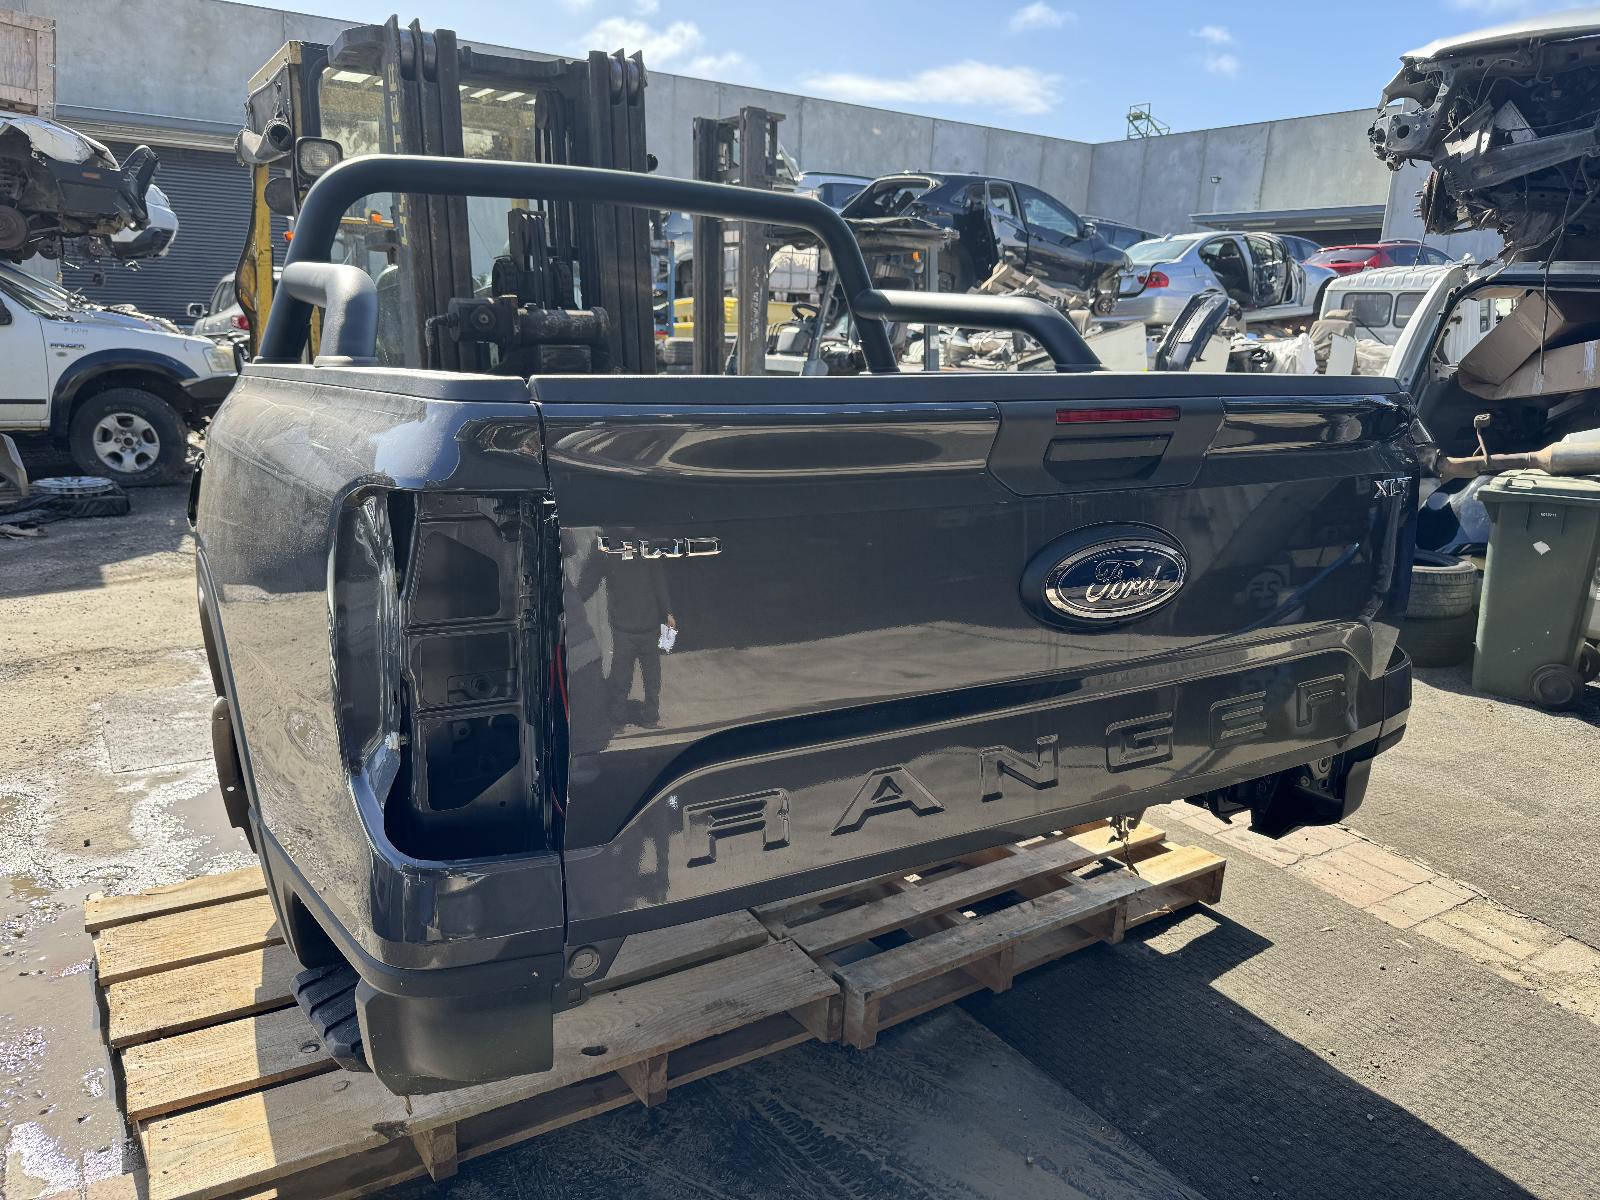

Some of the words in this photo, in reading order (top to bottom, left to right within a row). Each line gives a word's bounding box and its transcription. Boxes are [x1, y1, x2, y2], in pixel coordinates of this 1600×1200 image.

[1374, 476, 1412, 498] XLT
[597, 535, 722, 560] 4WD
[1085, 558, 1162, 603] Ford
[683, 671, 1346, 869] RANGER
